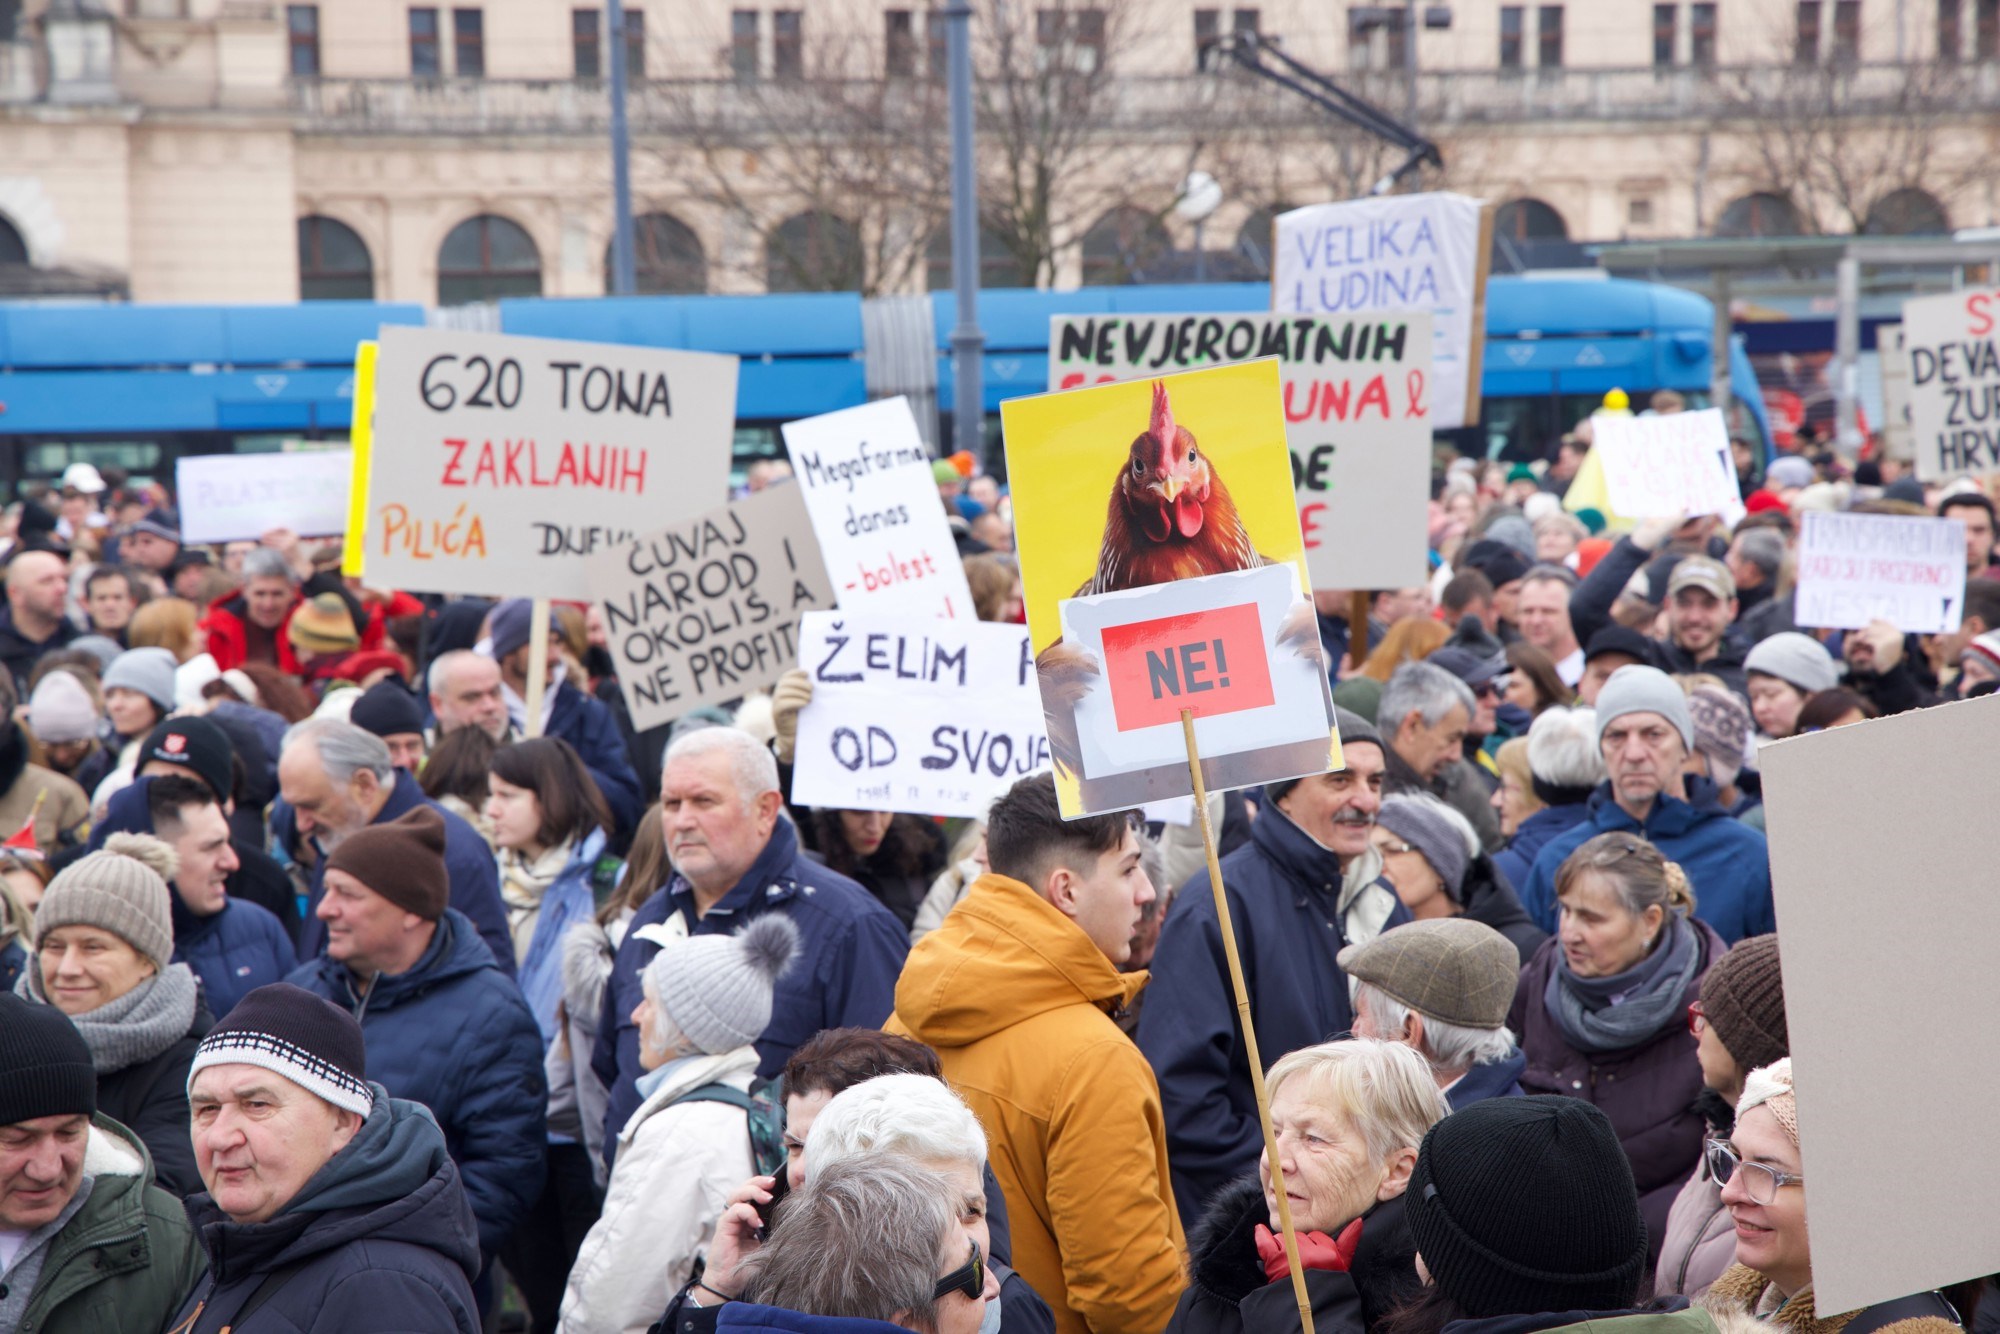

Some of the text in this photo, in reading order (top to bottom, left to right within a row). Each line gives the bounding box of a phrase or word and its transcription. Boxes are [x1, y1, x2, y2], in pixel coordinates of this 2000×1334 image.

[1296, 216, 1438, 270] VELIKA
[1295, 264, 1439, 314] LUDINA
[1966, 290, 2000, 336] S
[1059, 317, 1408, 369] NEVJEROJATNIH
[419, 353, 673, 419] 620 TONA
[1284, 373, 1391, 423] UNA
[439, 438, 649, 495] ZAKLANIH
[378, 502, 488, 559] PILIĆA
[843, 504, 910, 537] danas
[603, 536, 796, 634] NAROD I
[791, 580, 816, 610] A
[633, 620, 802, 709] NE PROFIT
[816, 620, 967, 687] ŽELIM
[1145, 638, 1231, 700] NE!
[830, 725, 898, 772] OD
